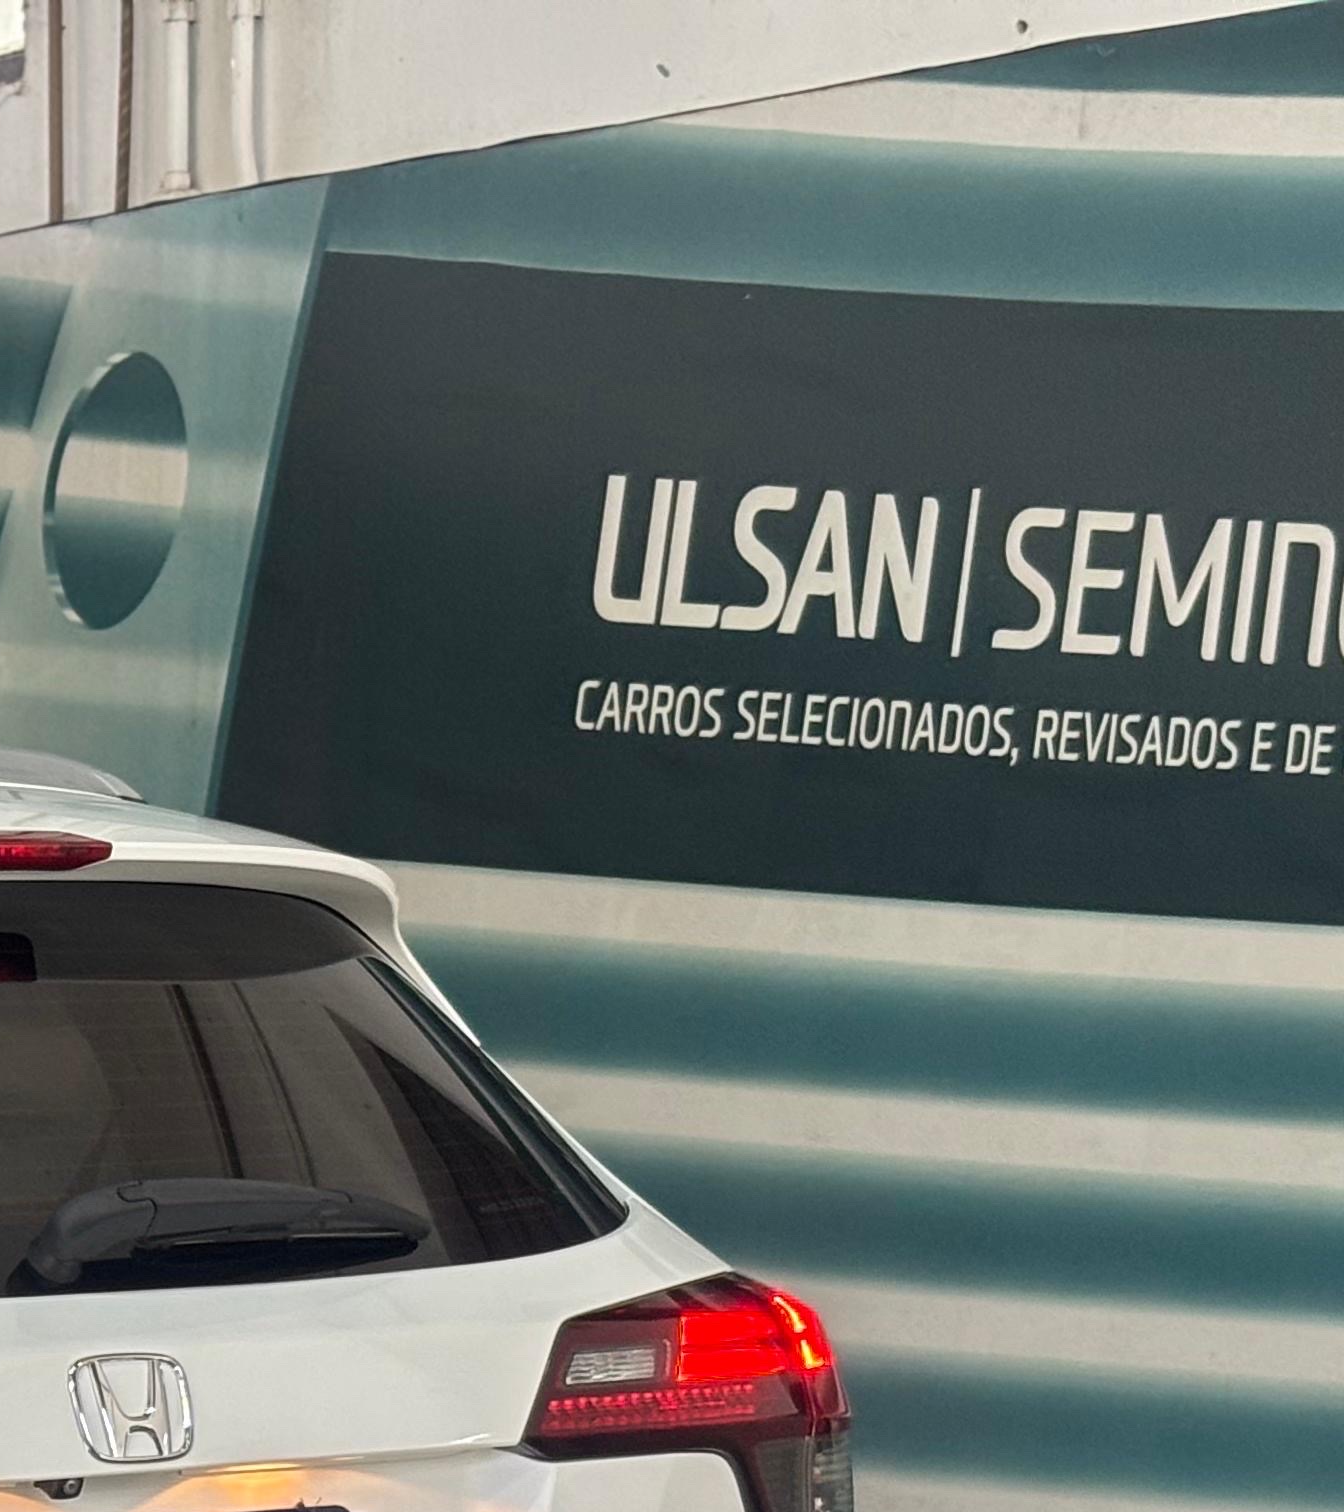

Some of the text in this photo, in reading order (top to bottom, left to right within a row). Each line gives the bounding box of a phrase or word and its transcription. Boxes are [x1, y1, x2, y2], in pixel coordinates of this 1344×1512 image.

[593, 474, 1344, 668] ULSAN SEMIN
[574, 679, 1337, 776] CARROS SELECIONADOS, REVISADOS E DE
